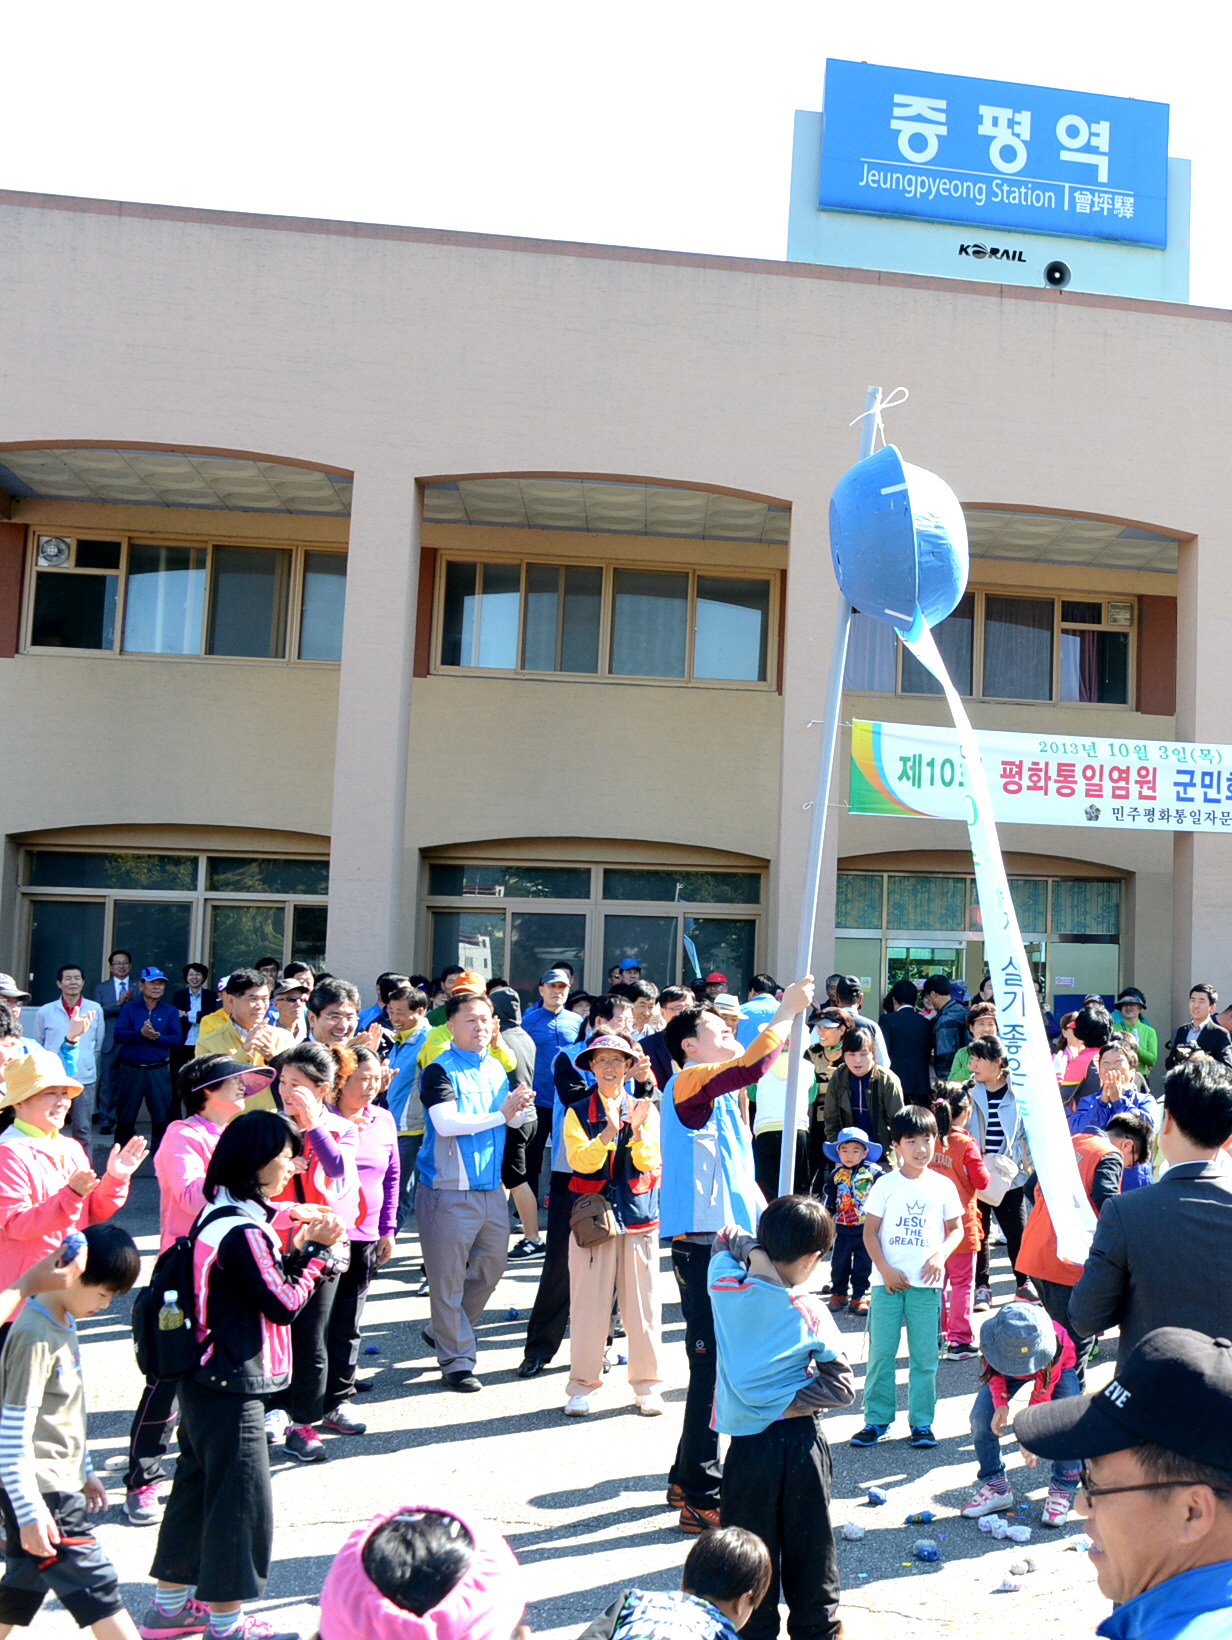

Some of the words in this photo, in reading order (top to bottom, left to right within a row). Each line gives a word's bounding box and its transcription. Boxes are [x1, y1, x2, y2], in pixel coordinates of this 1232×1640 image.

[890, 93, 1110, 183] 증평역
[859, 163, 987, 206] Jeungpyeong
[991, 179, 1055, 209] Station
[1073, 189, 1135, 219] 曾坪驛
[958, 243, 1027, 264] KORAIL
[1039, 740, 1098, 759] 2013년
[1108, 742, 1149, 762] 10월
[1158, 745, 1222, 766] 3일(목)
[898, 753, 967, 789] 제10
[1000, 758, 1158, 801] 평화통일염원
[895, 1215, 931, 1229] JESU
[904, 1227, 923, 1238] THE
[1104, 1380, 1132, 1408] EVE
